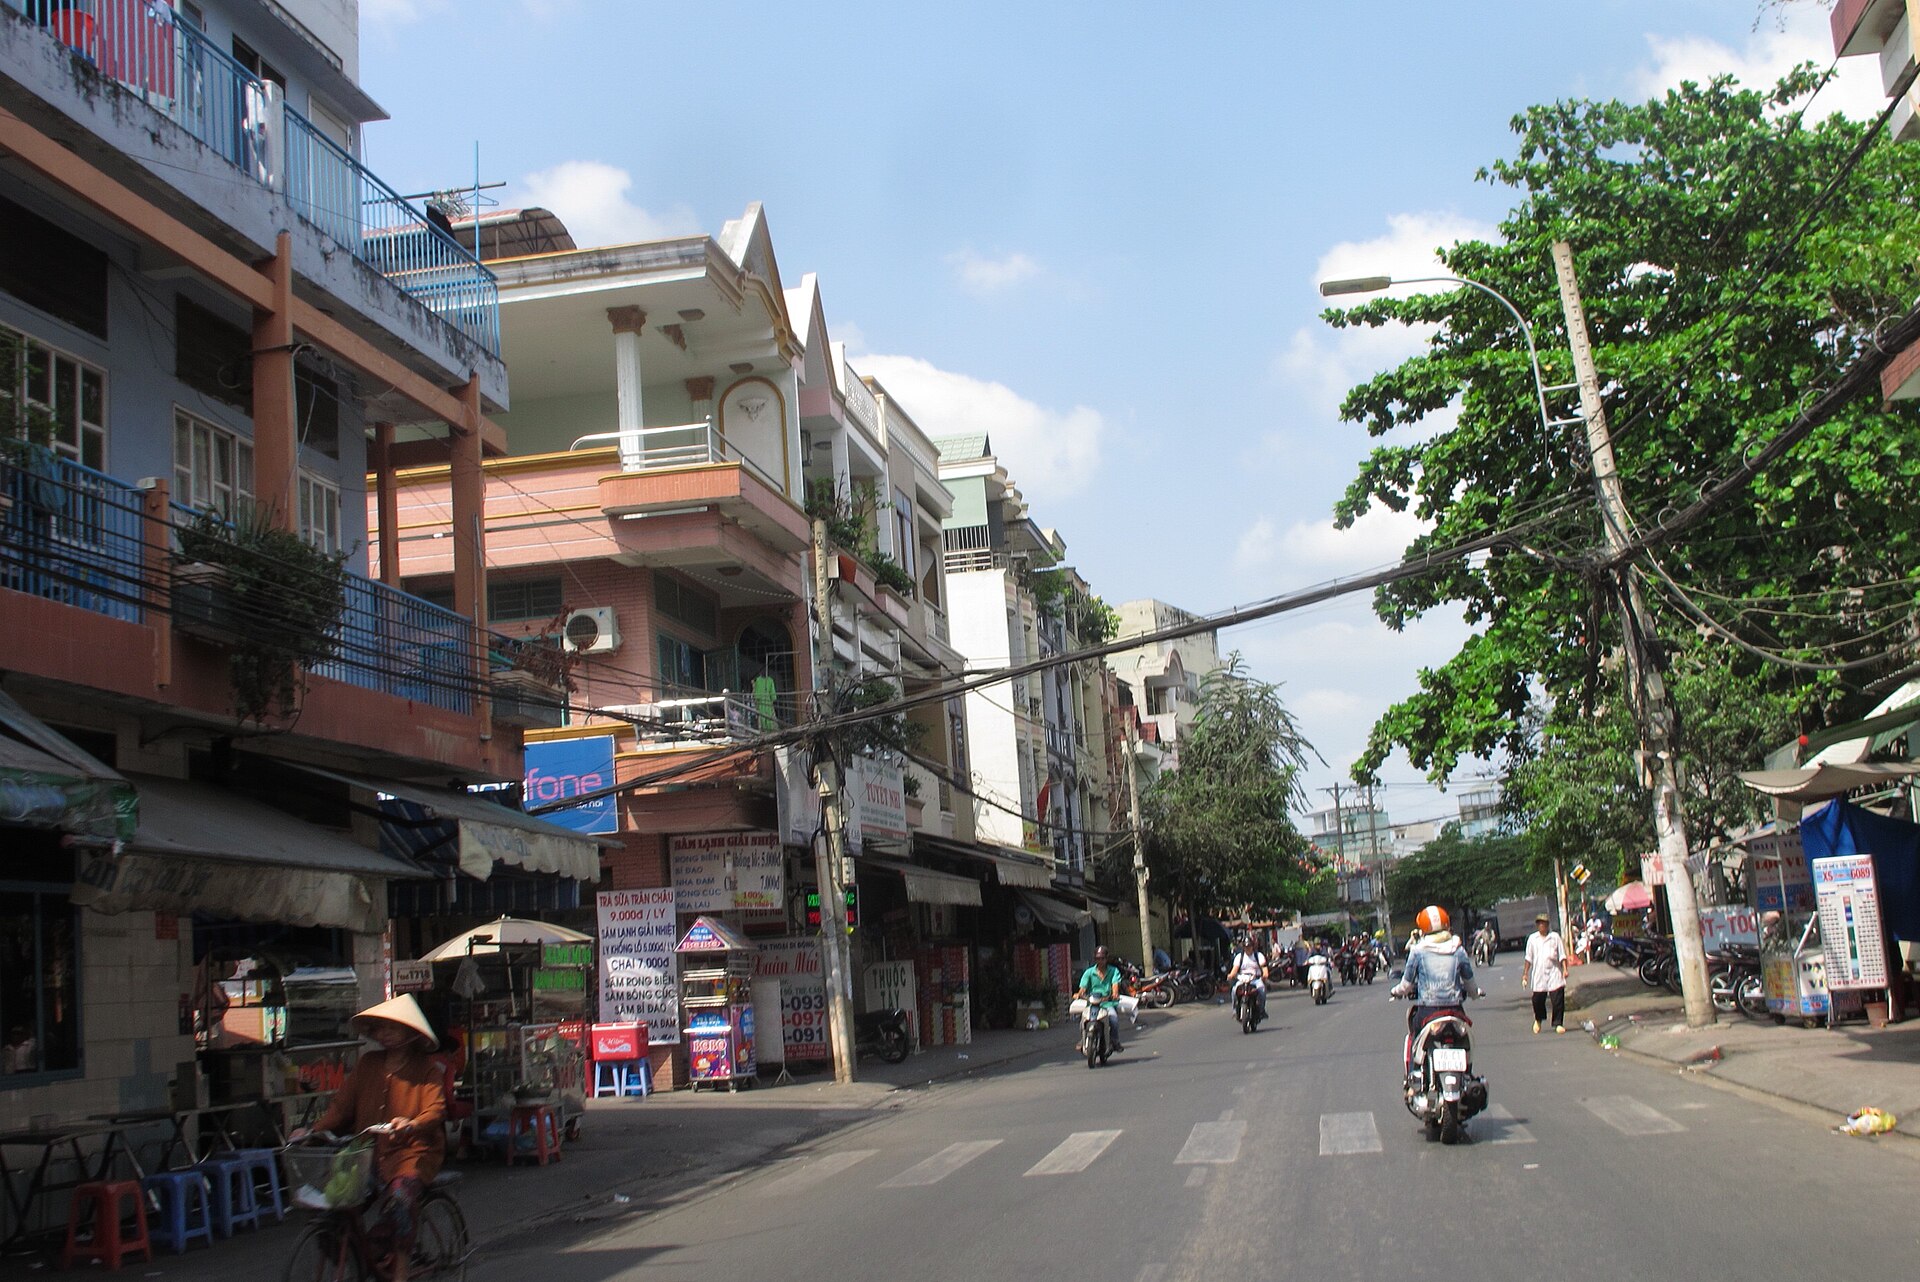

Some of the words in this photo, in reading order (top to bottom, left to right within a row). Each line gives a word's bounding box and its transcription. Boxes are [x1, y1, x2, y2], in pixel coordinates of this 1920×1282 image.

[1850, 867, 1870, 880] 6089
[611, 909, 643, 922] 9.000đ
[654, 908, 665, 919] LY
[611, 958, 635, 971] CHAI
[637, 957, 669, 969] 7.000đ
[627, 976, 652, 987] RONG
